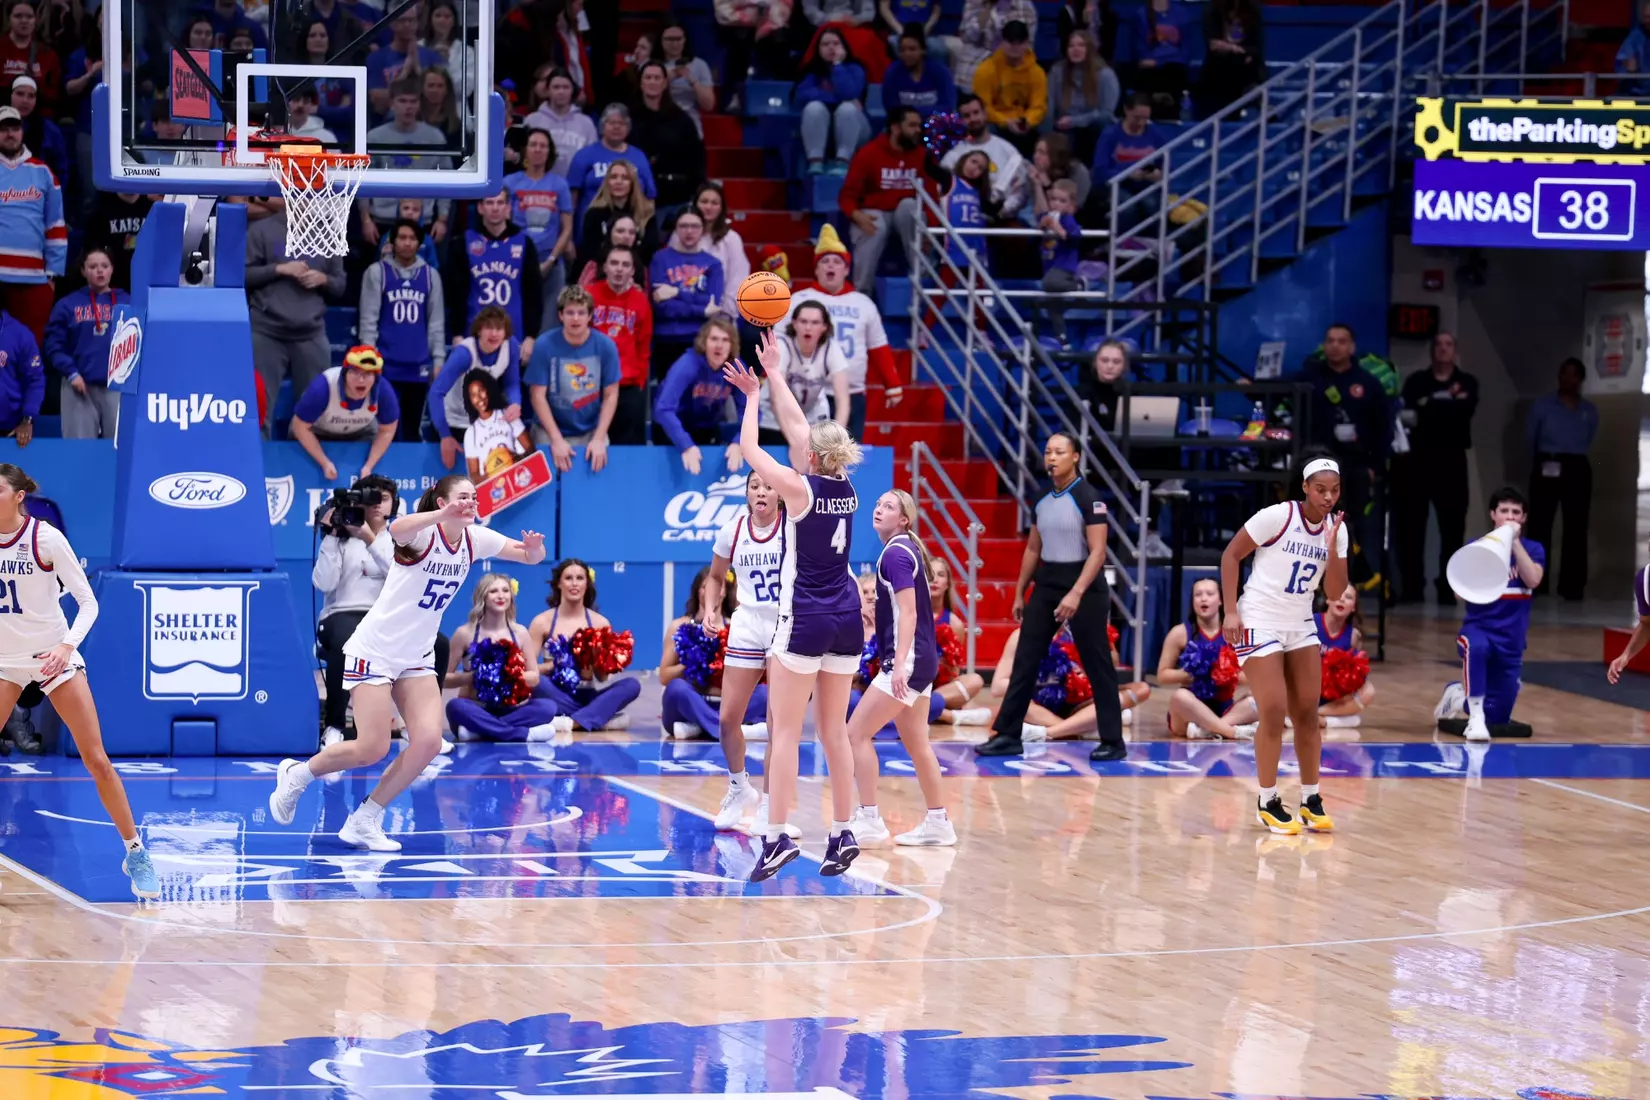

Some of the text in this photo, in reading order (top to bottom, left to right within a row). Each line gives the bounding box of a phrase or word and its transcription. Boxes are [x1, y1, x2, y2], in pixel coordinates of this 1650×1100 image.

[123, 167, 160, 176] SPALDING
[1414, 190, 1609, 230] KANSAS 38
[471, 260, 518, 279] KANSAS
[387, 288, 425, 304] KANSAS
[478, 278, 511, 306] 30
[393, 300, 419, 324] 00
[168, 477, 226, 501] Ford
[830, 517, 847, 555] 4
[750, 569, 781, 602] 22
[1284, 560, 1318, 594] 12
[0, 579, 23, 614] 21
[418, 579, 460, 612] 52
[154, 613, 238, 628] SHELTER
[154, 630, 237, 642] INSURANCE
